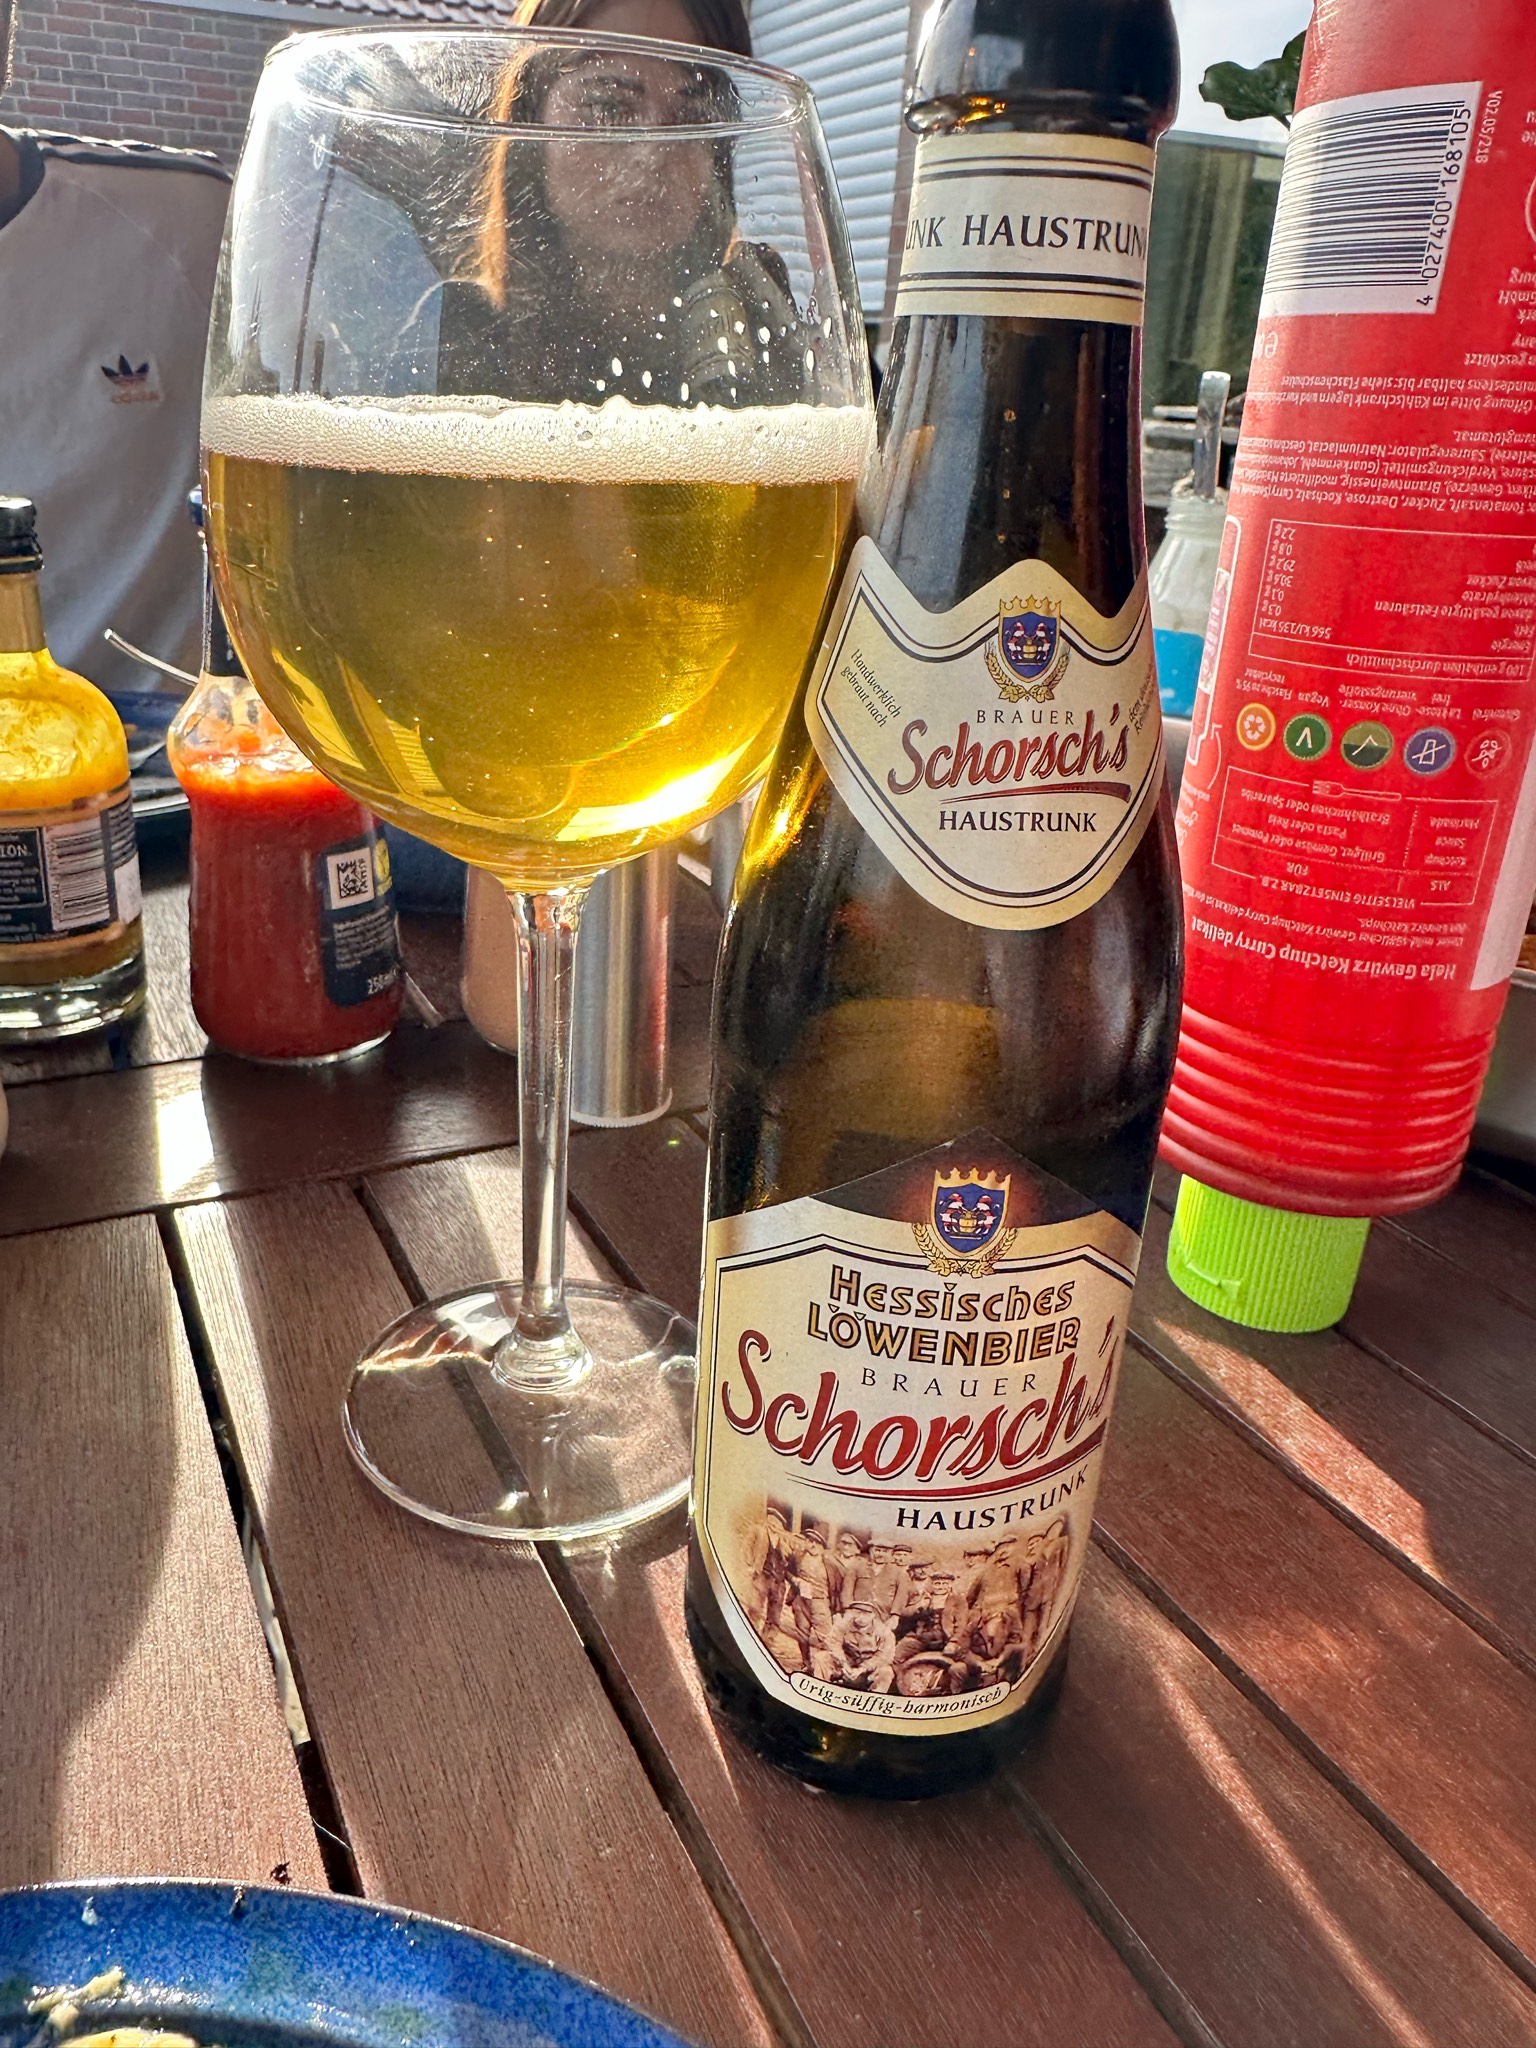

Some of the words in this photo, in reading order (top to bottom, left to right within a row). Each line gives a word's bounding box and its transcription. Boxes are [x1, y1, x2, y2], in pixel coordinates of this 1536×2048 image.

[1421, 200, 1452, 279] 027400
[1441, 108, 1471, 186] 168105
[905, 216, 946, 250] UNK
[1361, 376, 1392, 391] siehe
[1418, 378, 1466, 392] haltbar
[1320, 390, 1353, 408] lagern
[1355, 394, 1430, 410] Kühlschrank
[1433, 397, 1449, 410] im
[1451, 397, 1481, 411] bitte
[1344, 492, 1398, 509] Dextrose,
[1401, 496, 1446, 511] Zucker,
[851, 648, 902, 718] Handwerklich
[840, 666, 870, 703] gebraut
[865, 701, 888, 727] nach
[1298, 691, 1329, 707] Vegan
[977, 709, 1075, 725] BRAUER
[1382, 702, 1411, 716] Ohne
[887, 703, 1130, 795] Schorsch's
[938, 811, 1098, 834] HAUSTRUNK
[1271, 834, 1294, 848] oder
[1287, 862, 1309, 876] FÜR
[1280, 880, 1351, 902] EINSETZBAR
[1353, 893, 1415, 909] VIELSEITIG
[1192, 916, 1234, 947] delikat
[1235, 931, 1276, 959] Curry
[1280, 944, 1349, 974] Ketchup
[1352, 960, 1417, 979] Gewürz
[830, 1264, 1075, 1323] Hessisches
[808, 1303, 1081, 1367] LÖWENBIER
[862, 1367, 1036, 1397] BRAUER
[898, 1464, 1089, 1530] HAUSTRUNK
